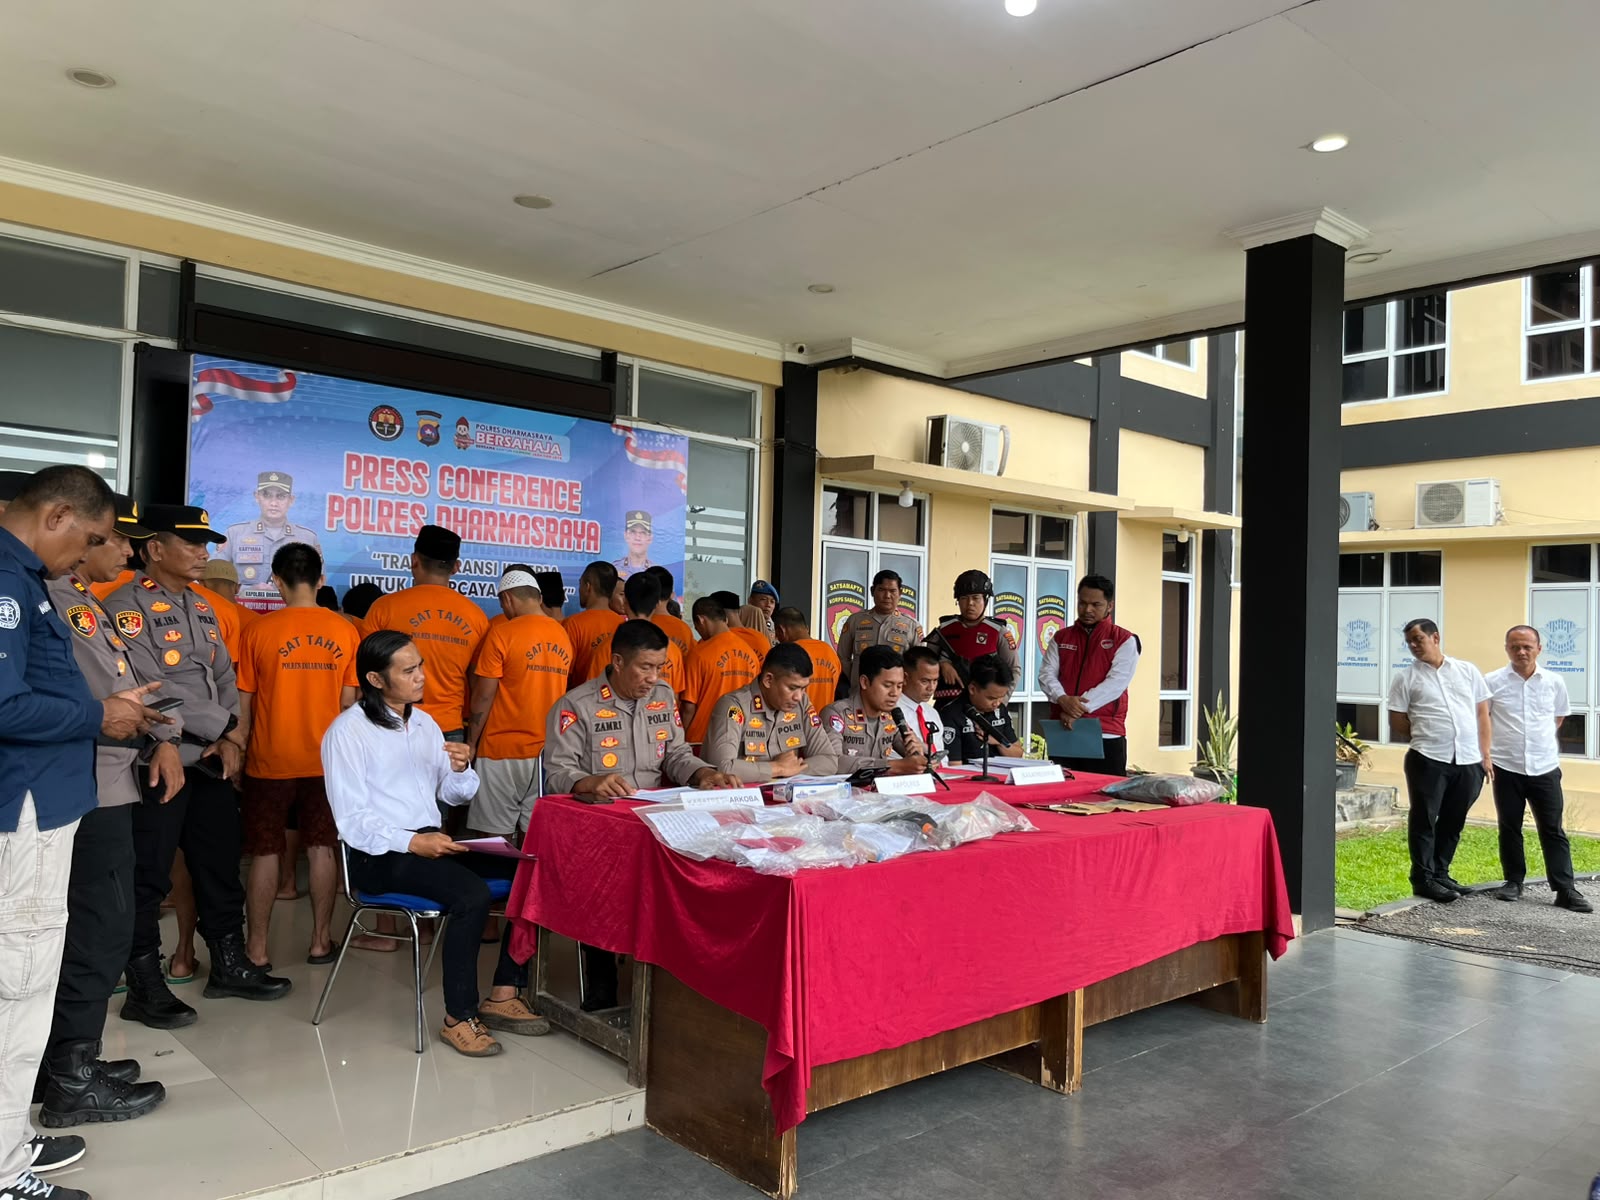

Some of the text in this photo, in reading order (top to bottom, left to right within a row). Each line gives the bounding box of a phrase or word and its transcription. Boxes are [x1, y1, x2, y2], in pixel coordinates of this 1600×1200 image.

[476, 423, 553, 441] POLRES DHARMASRAYA
[475, 432, 562, 455] BERSAHAJA
[344, 452, 582, 513] PRESS CONFERENCE
[326, 494, 600, 552] POLRES DHARMASRAYA
[829, 583, 863, 593] SATSAMAPTA
[154, 616, 180, 628] M.ISA
[409, 609, 472, 636] SAT TAHTI
[278, 634, 344, 659] SAT TAHTI
[526, 642, 570, 666] SAT TAHTI
[717, 649, 756, 669] SAT TAHTI
[815, 657, 837, 675] TAHTI
[594, 720, 622, 732] ZAMRI
[647, 712, 671, 725] POLRI
[778, 723, 801, 735] POLRI
